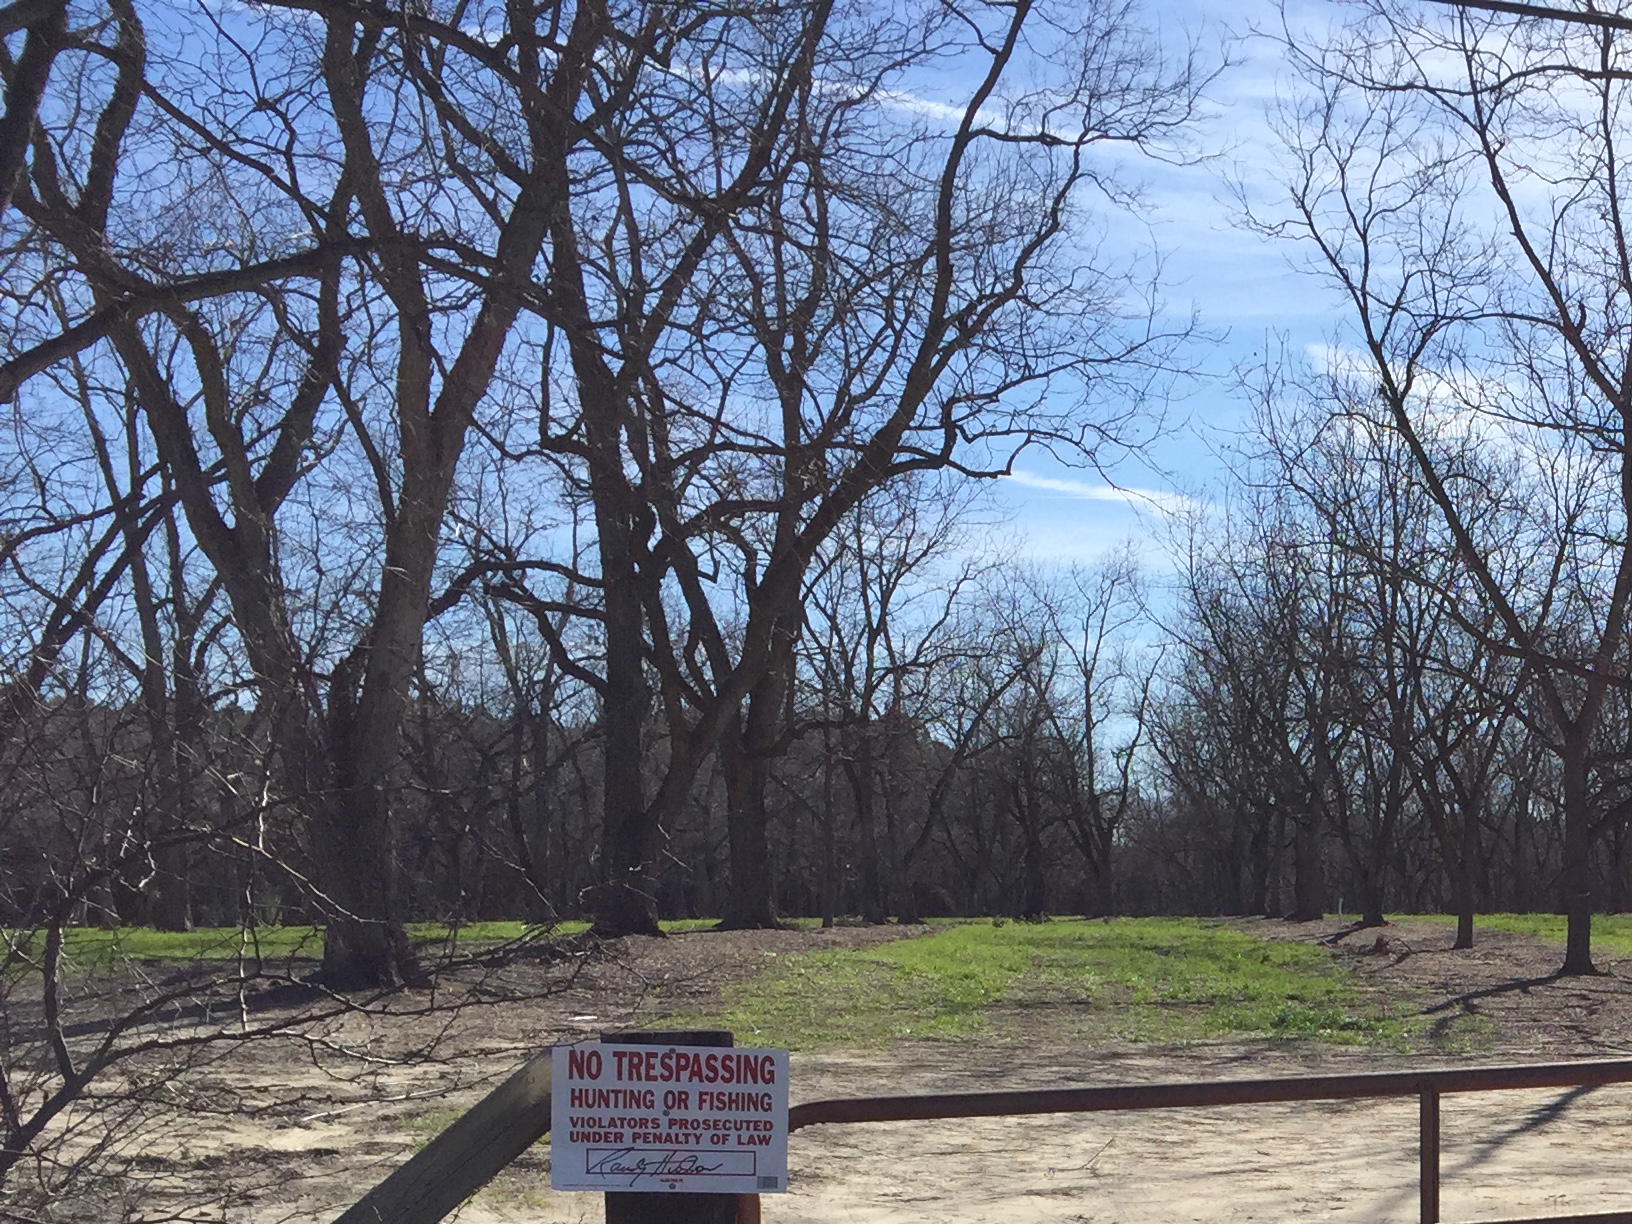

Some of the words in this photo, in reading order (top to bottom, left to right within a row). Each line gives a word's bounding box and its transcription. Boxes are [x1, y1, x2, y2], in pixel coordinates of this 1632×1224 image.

[568, 1050, 602, 1080] NO
[613, 1051, 775, 1085] TRESPASSING
[570, 1089, 655, 1109] HUNTING
[664, 1090, 689, 1110] OR
[698, 1092, 772, 1112] FISHING
[570, 1116, 660, 1129] VIOLATORS
[668, 1118, 774, 1131] PROSECUTED
[570, 1131, 624, 1144] UNDER
[632, 1132, 703, 1145] PENALTY
[710, 1133, 731, 1145] OF
[737, 1134, 772, 1146] LAW
